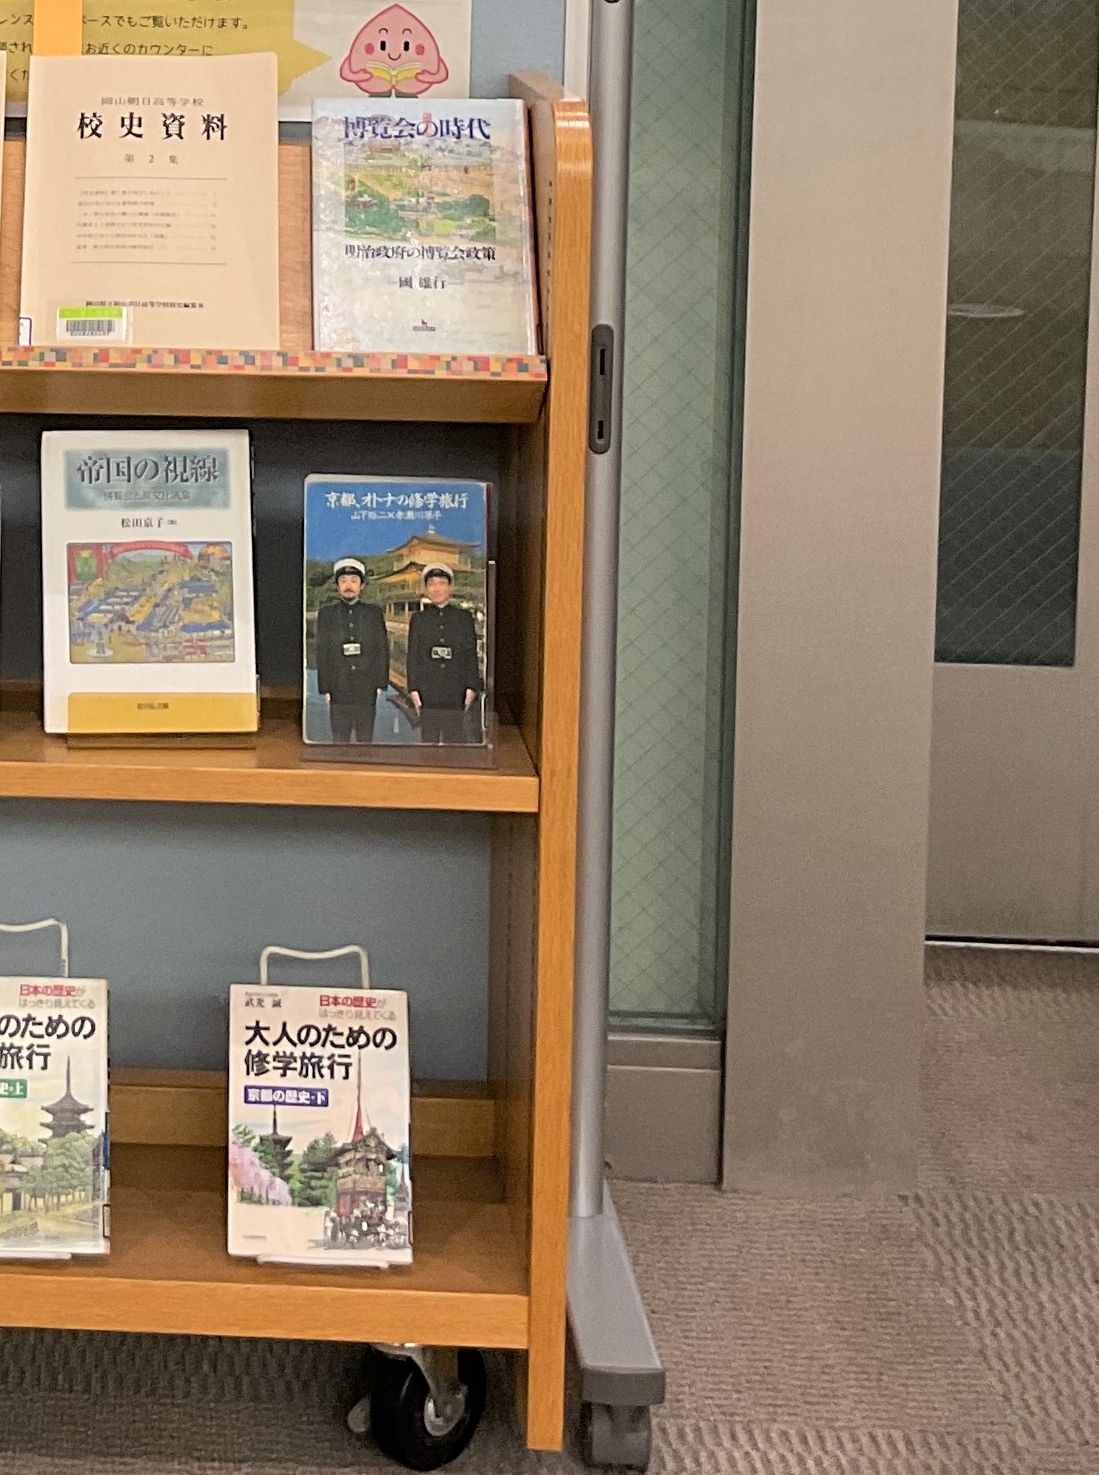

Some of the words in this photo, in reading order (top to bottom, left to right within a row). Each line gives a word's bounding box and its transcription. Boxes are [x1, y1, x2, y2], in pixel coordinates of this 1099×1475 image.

[77, 111, 228, 141] 校史資料
[344, 116, 492, 140] 博覧会の時代
[77, 454, 219, 485] 帝国の視線
[245, 1020, 397, 1050] 大人のための
[244, 1049, 353, 1080] 修学旅行
